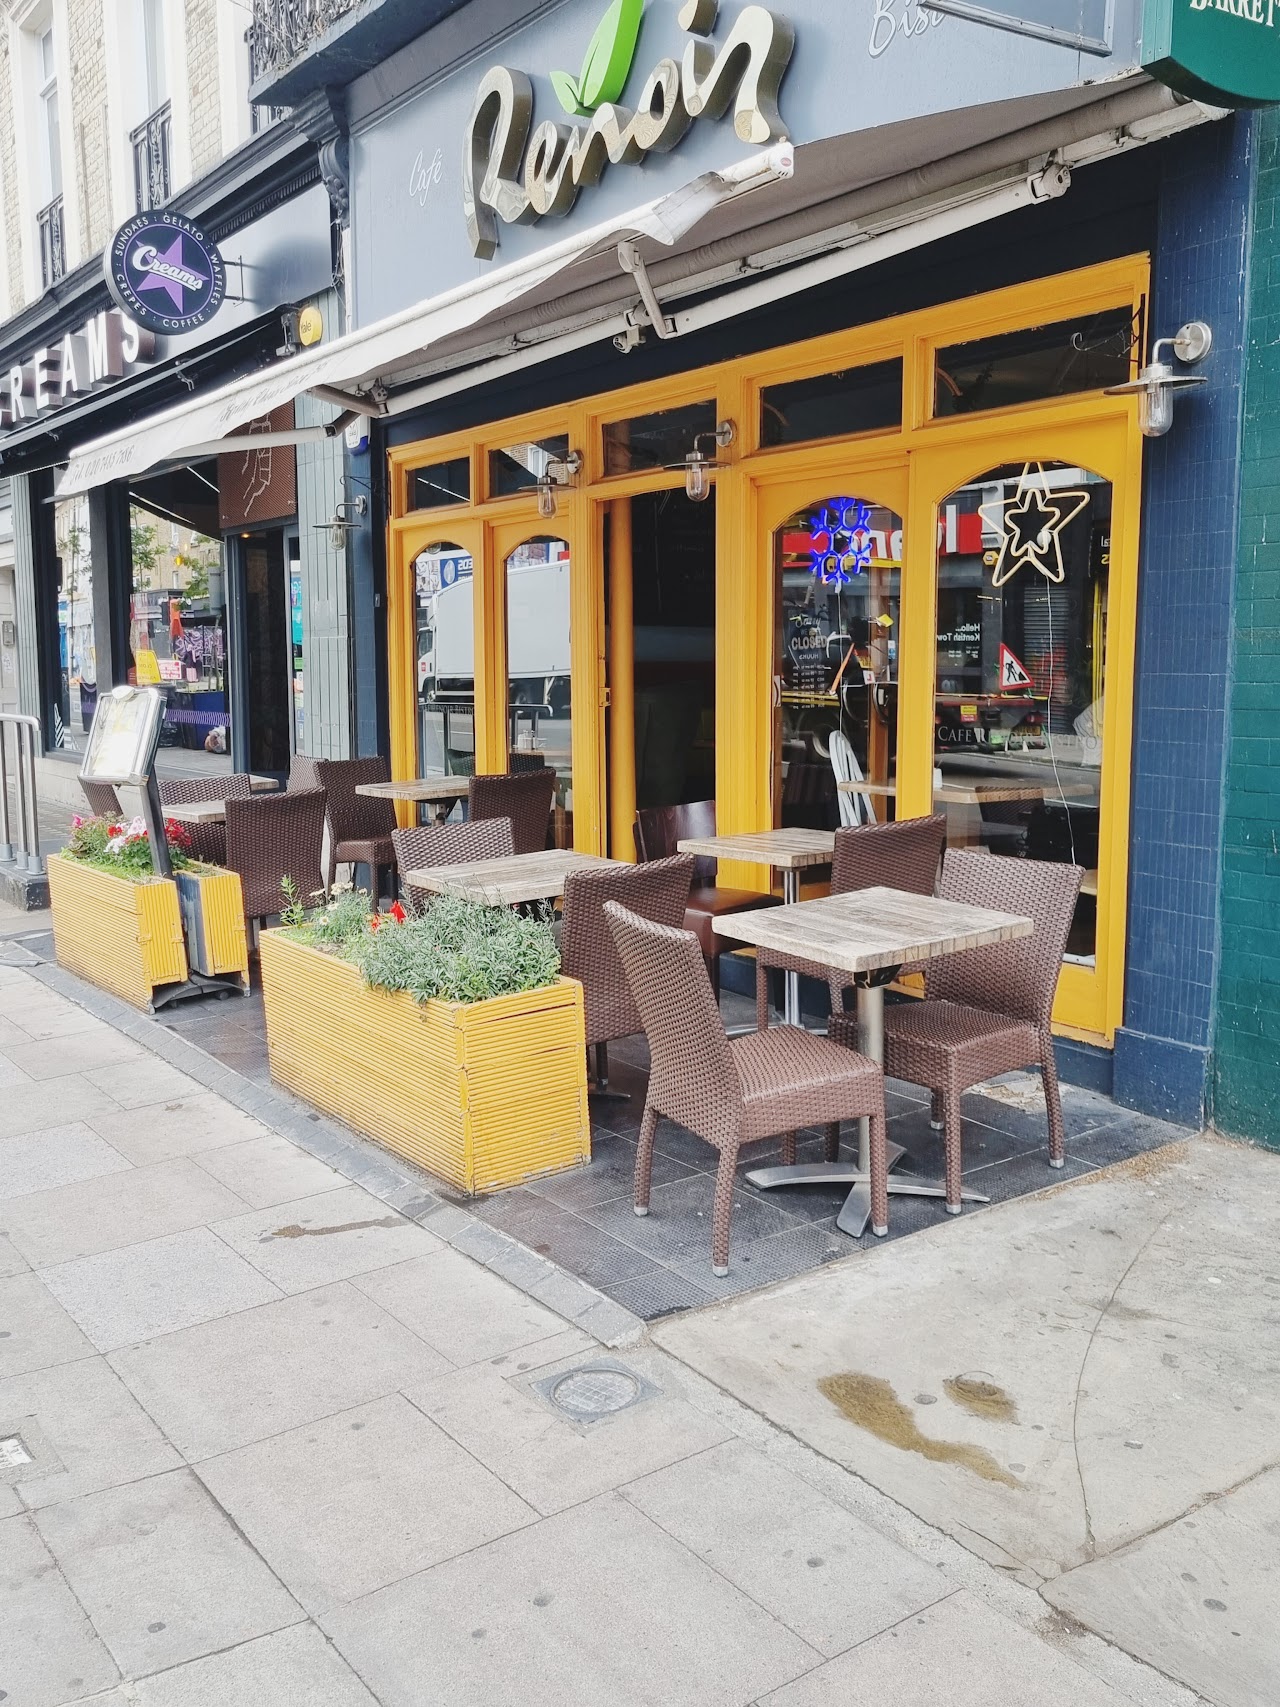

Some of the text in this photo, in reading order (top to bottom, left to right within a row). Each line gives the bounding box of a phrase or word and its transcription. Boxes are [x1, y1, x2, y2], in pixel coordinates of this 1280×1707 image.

[409, 148, 443, 207] Café
[463, 0, 792, 260] Renoir
[115, 216, 149, 257] SUNDAES
[162, 214, 204, 241] GELATO
[132, 245, 203, 291] Creams
[209, 253, 223, 306] WAFFLES
[117, 274, 147, 316] CREPES
[162, 313, 205, 329] COFFEE
[0, 311, 140, 428] REAMS
[791, 635, 828, 650] CLOSED
